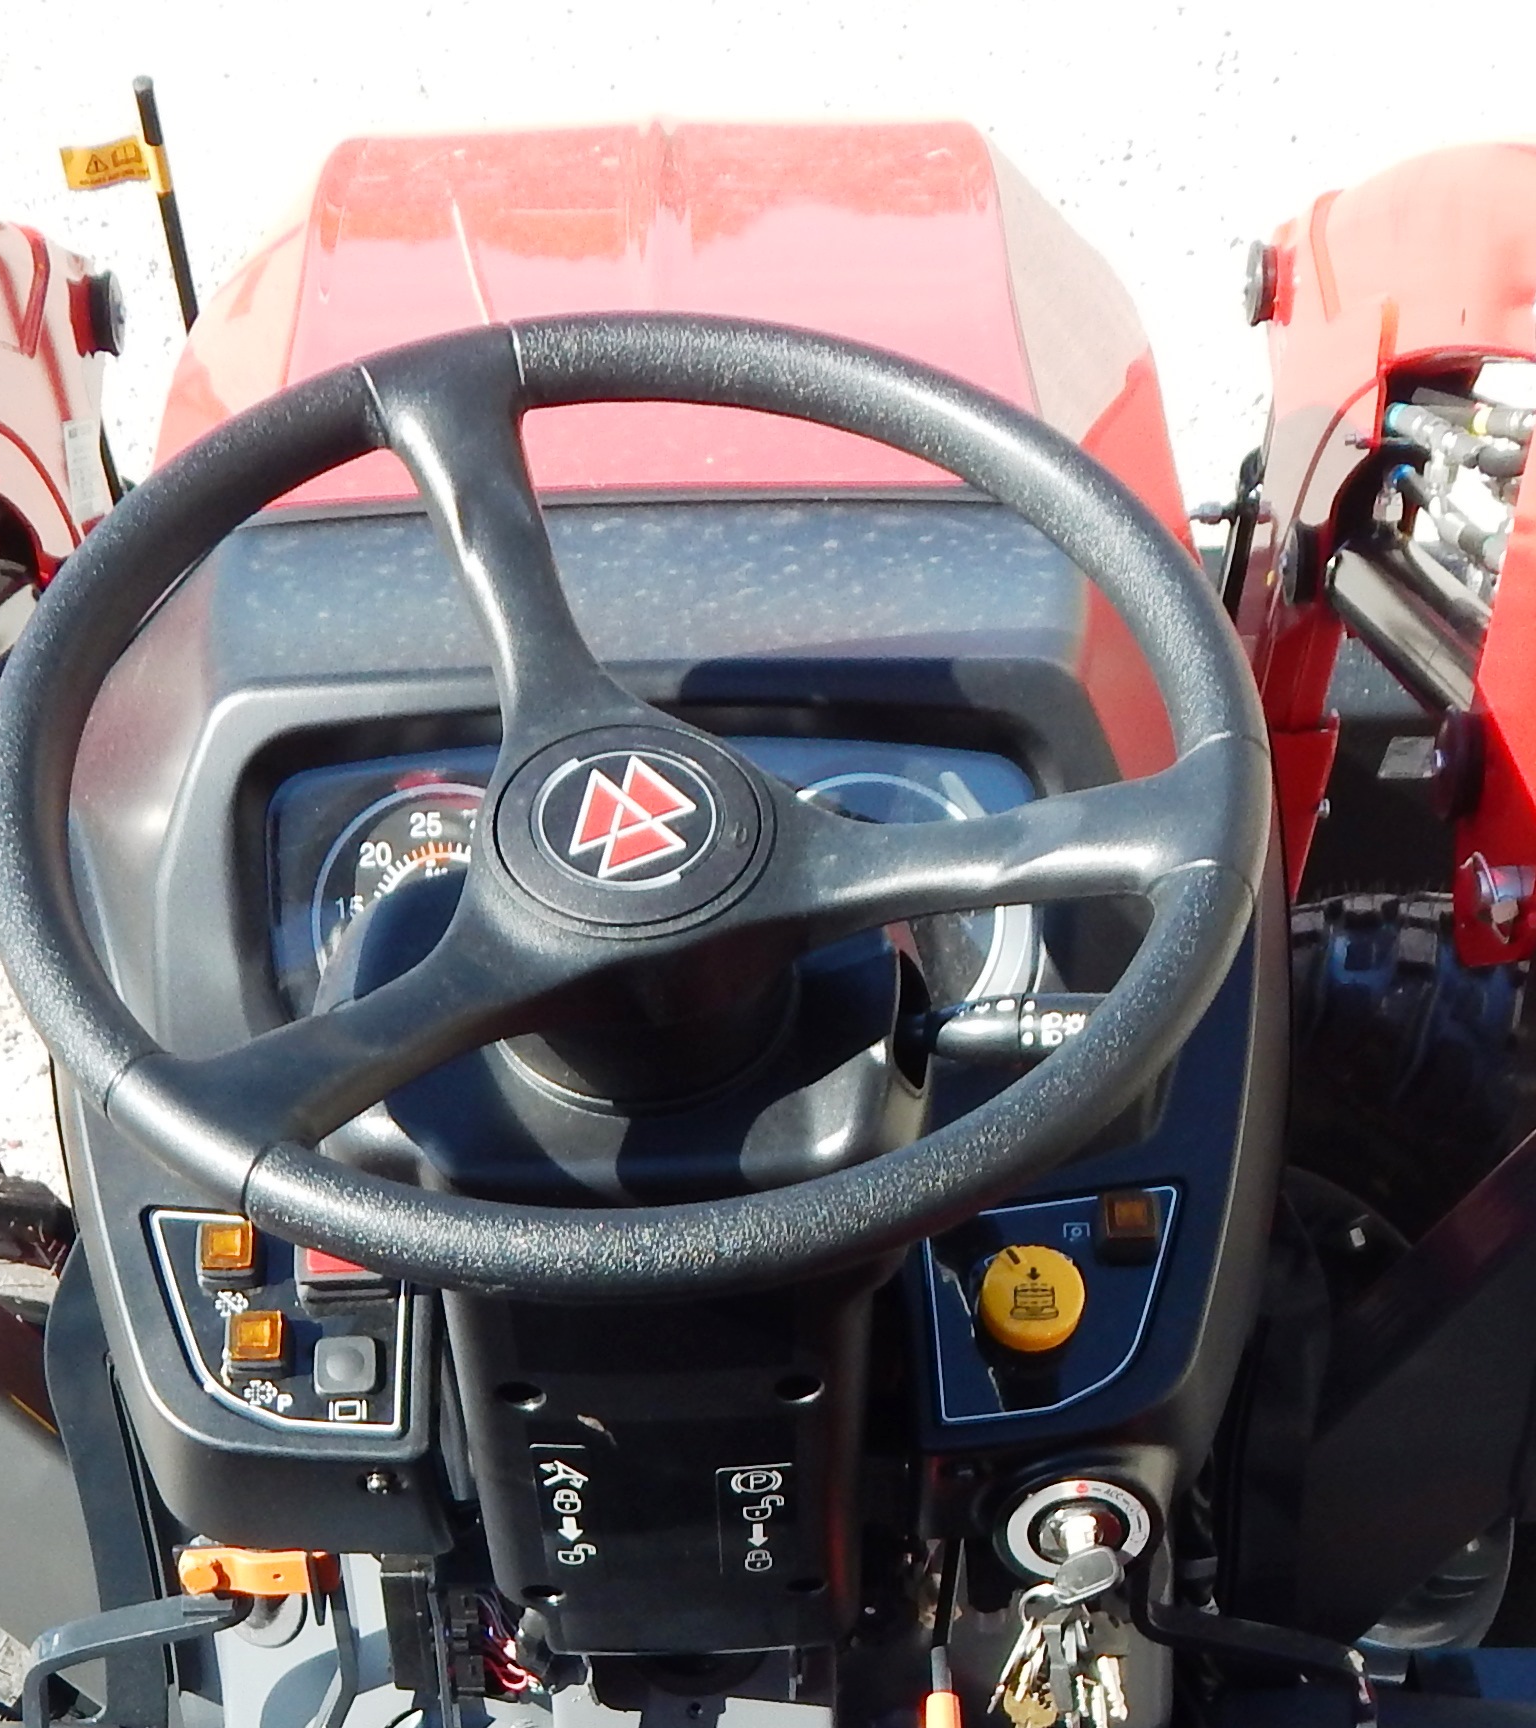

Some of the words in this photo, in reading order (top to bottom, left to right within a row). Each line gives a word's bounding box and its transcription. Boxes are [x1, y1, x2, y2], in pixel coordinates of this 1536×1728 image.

[409, 811, 443, 838] 25
[359, 842, 393, 867] 20
[276, 1393, 293, 1413] P
[1103, 1488, 1123, 1500] ACC
